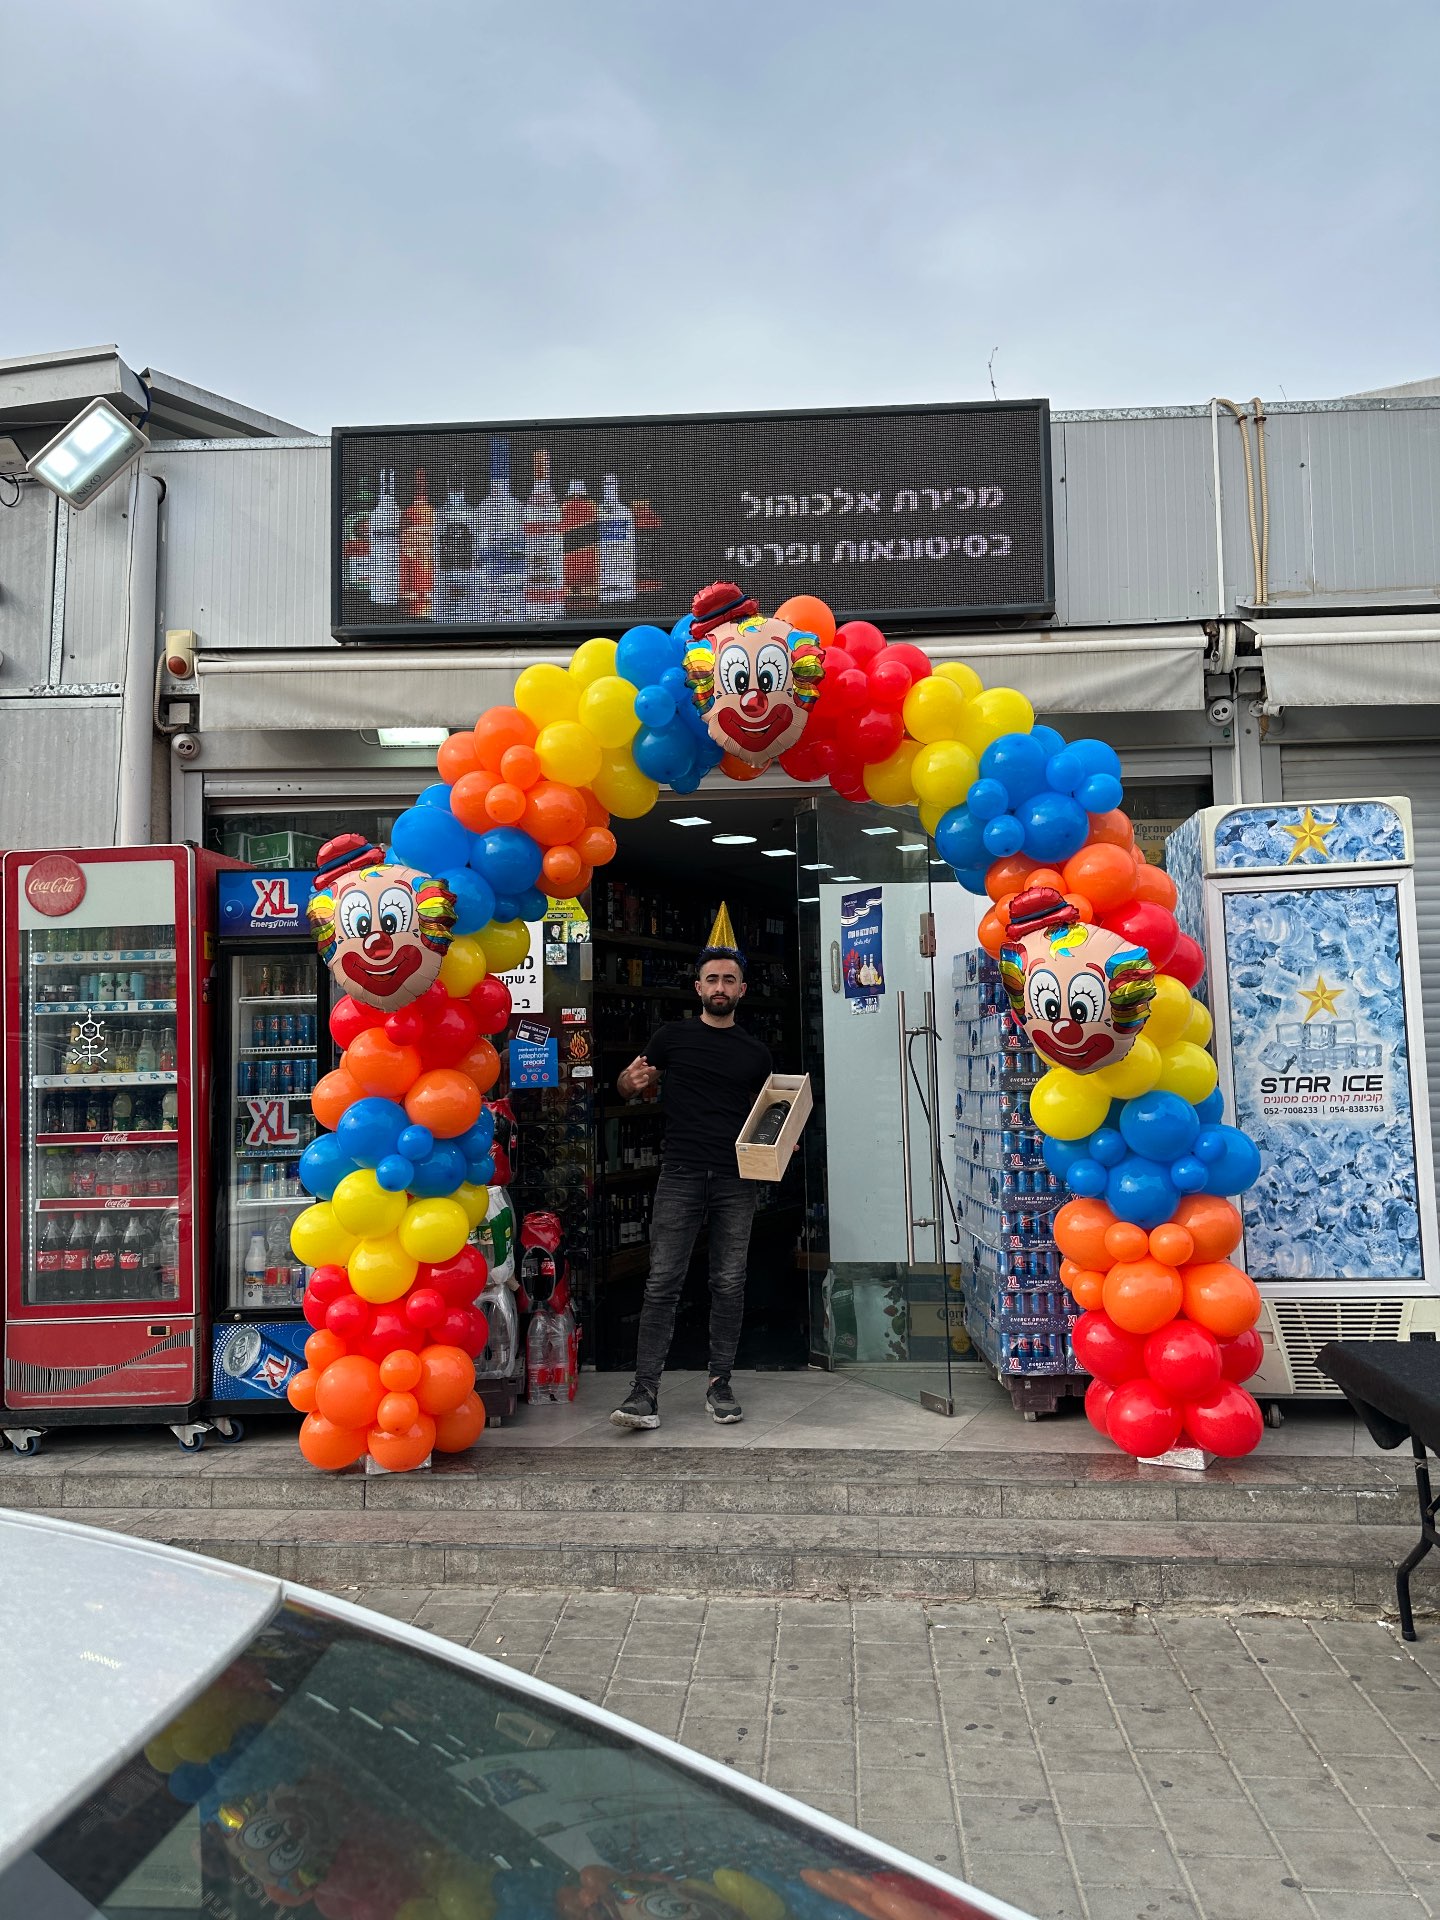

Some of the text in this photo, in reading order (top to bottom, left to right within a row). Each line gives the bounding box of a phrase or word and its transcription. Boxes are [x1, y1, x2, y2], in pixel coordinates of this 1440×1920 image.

[741, 486, 1003, 518] מכירת אלכוהול
[251, 879, 298, 918] XL
[1009, 1036, 1020, 1047] XL
[1260, 1075, 1384, 1093] STAR ICE
[1263, 1093, 1383, 1104] קוביות קרח ממים מסוננים
[1264, 1105, 1384, 1114] 052-7008233 054-8383763
[245, 1100, 299, 1146] XL
[1010, 1112, 1023, 1125] XL
[1010, 1153, 1023, 1166] XL
[1010, 1235, 1023, 1248] XL
[1007, 1275, 1020, 1288] XL
[1008, 1357, 1022, 1370] XL
[253, 1353, 292, 1390] XL
